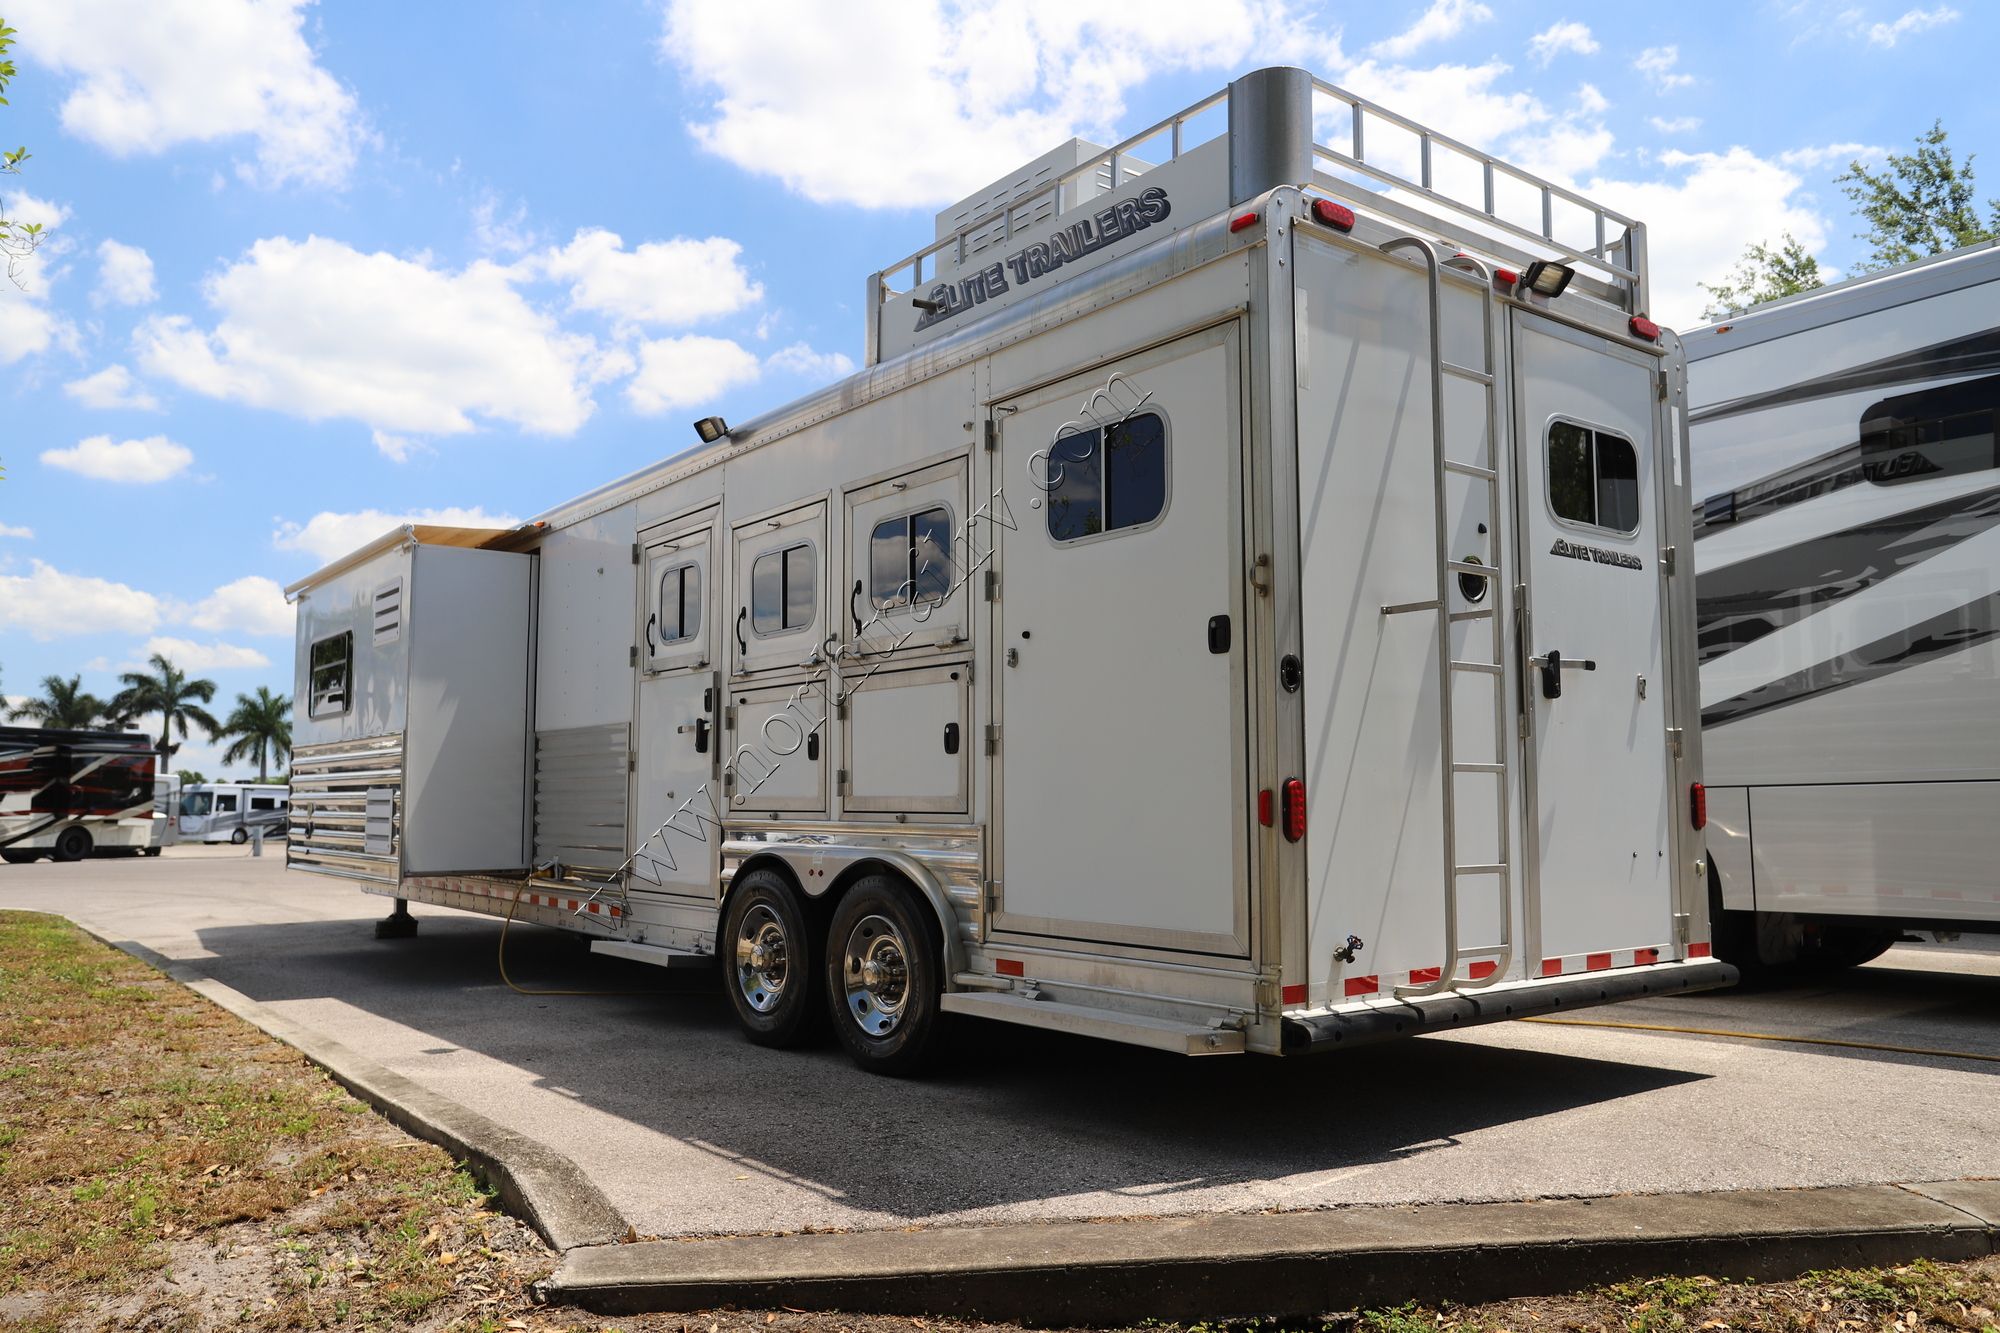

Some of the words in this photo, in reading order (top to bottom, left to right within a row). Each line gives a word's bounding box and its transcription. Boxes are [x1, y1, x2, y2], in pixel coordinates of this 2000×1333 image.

[913, 261, 1010, 332] ELITE
[1005, 187, 1171, 285] TRAILERS
[1550, 537, 1591, 562] ELITE
[1588, 546, 1643, 571] TRAILERS
